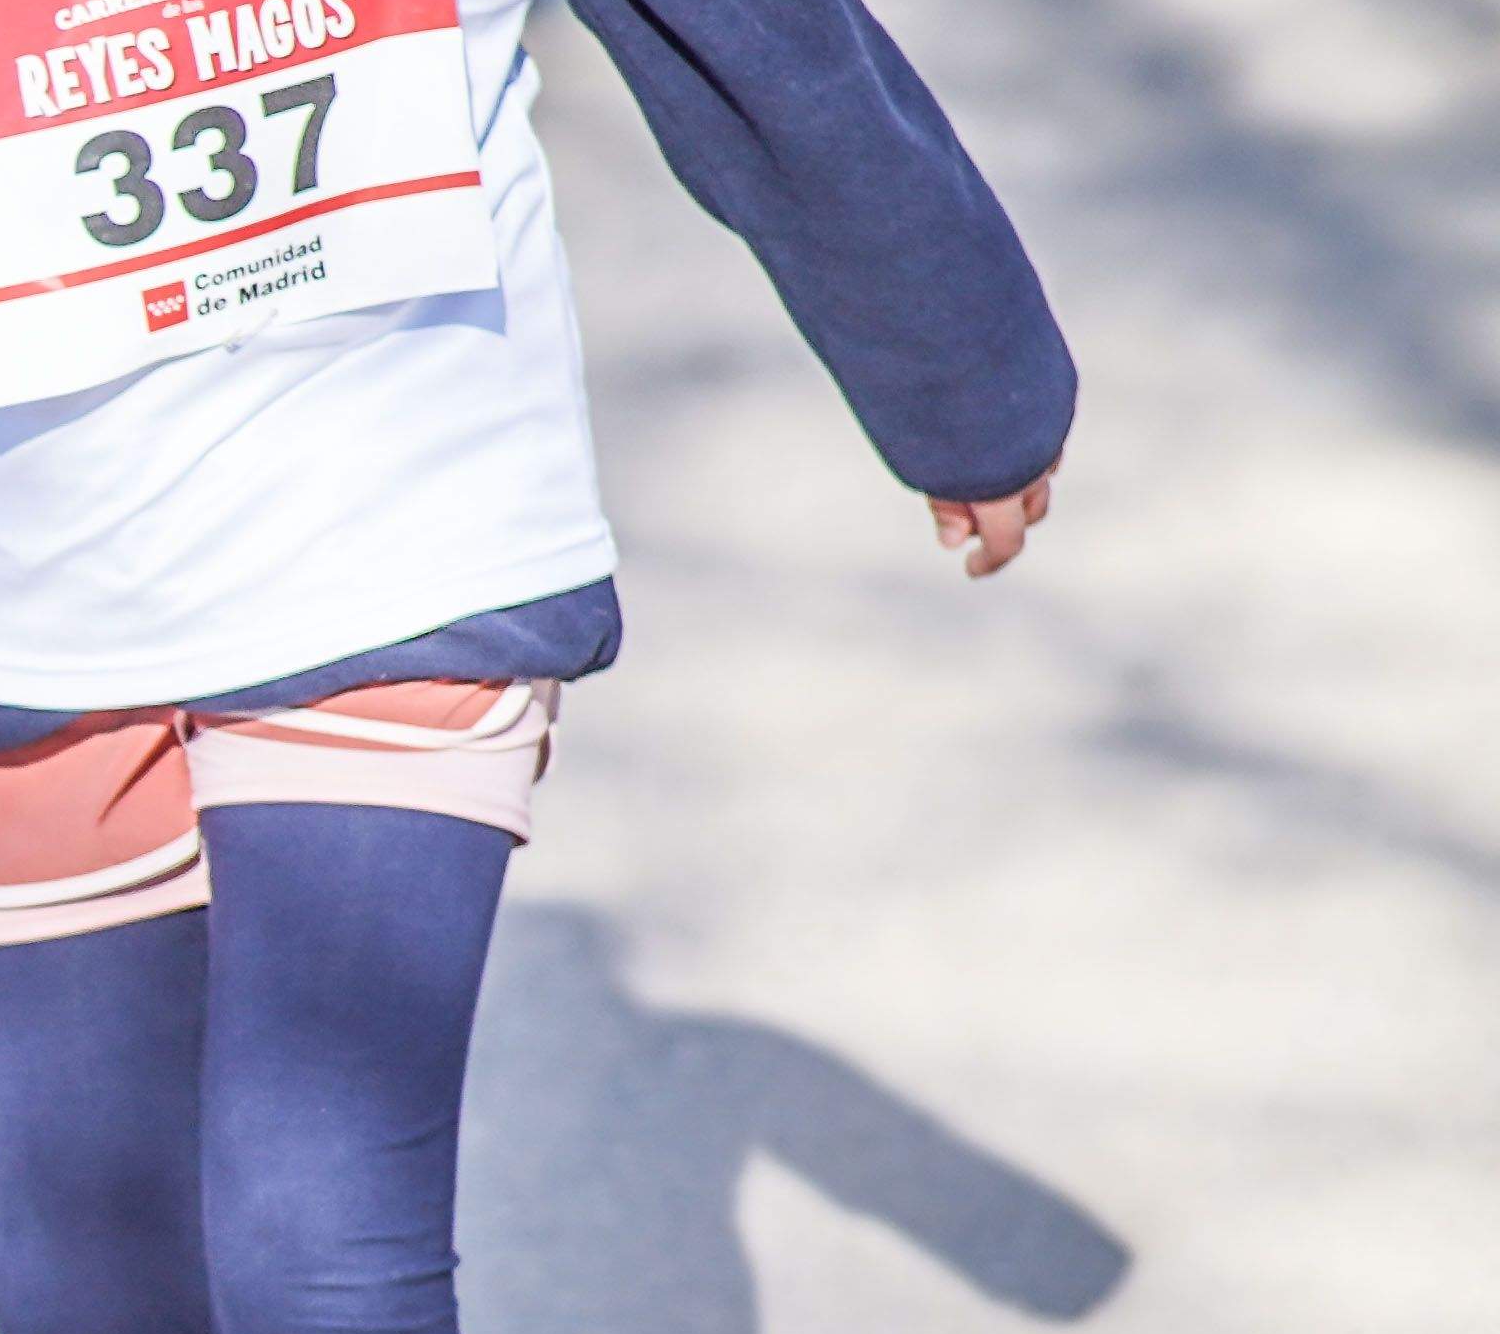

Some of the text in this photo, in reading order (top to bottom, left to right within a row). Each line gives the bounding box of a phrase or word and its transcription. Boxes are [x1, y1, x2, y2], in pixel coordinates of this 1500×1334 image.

[15, 28, 175, 118] REYES
[74, 73, 337, 247] 337
[195, 234, 323, 291] Comunidad
[197, 260, 327, 316] de Madrid
